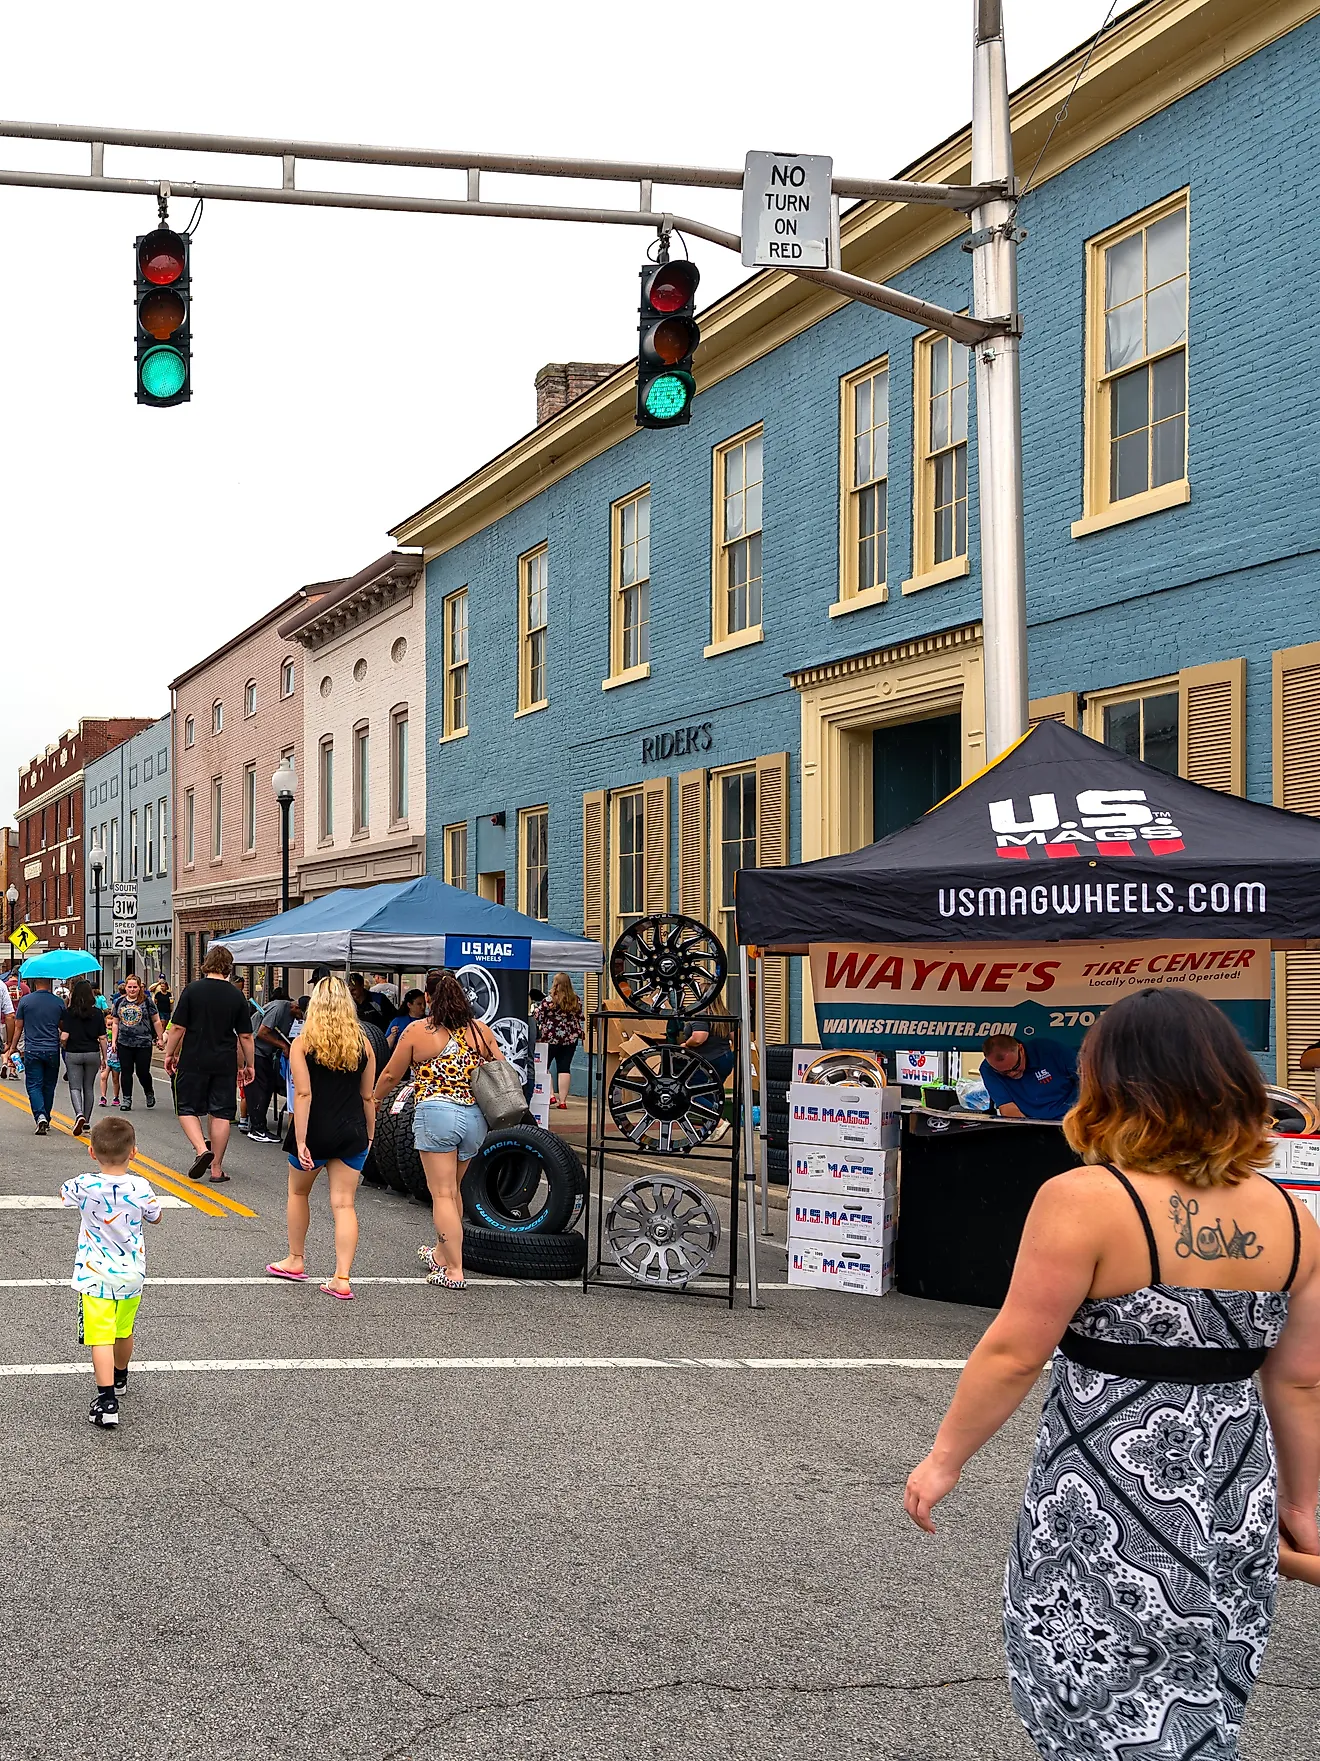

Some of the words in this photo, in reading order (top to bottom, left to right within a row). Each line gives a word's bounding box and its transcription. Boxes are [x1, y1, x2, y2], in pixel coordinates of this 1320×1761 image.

[771, 164, 806, 187] NO
[764, 193, 810, 211] TURN
[774, 218, 797, 235] ON
[769, 242, 803, 258] RED
[641, 722, 713, 764] RIDER'S
[988, 789, 1173, 834] U.S.
[995, 825, 1183, 847] MAGS
[114, 883, 137, 892] SOUTH
[114, 900, 136, 915] 31W
[938, 881, 1267, 918] USMAGWHEELS.COM
[114, 936, 134, 948] 25
[823, 951, 1063, 994] WAYNE'S
[1081, 957, 1145, 977] TIRE
[1147, 949, 1257, 974] CENTER
[1088, 977, 1126, 988] Locally
[1128, 975, 1163, 986] Owned
[1165, 974, 1186, 983] and
[1187, 971, 1241, 983] Operated!
[822, 1018, 1018, 1038] WAYNESTIRECENTER.COM
[483, 1140, 521, 1157] RADIAL
[475, 1203, 507, 1231] COBRA
[509, 1208, 550, 1233] COOPER
[1169, 1189, 1265, 1261] Love
